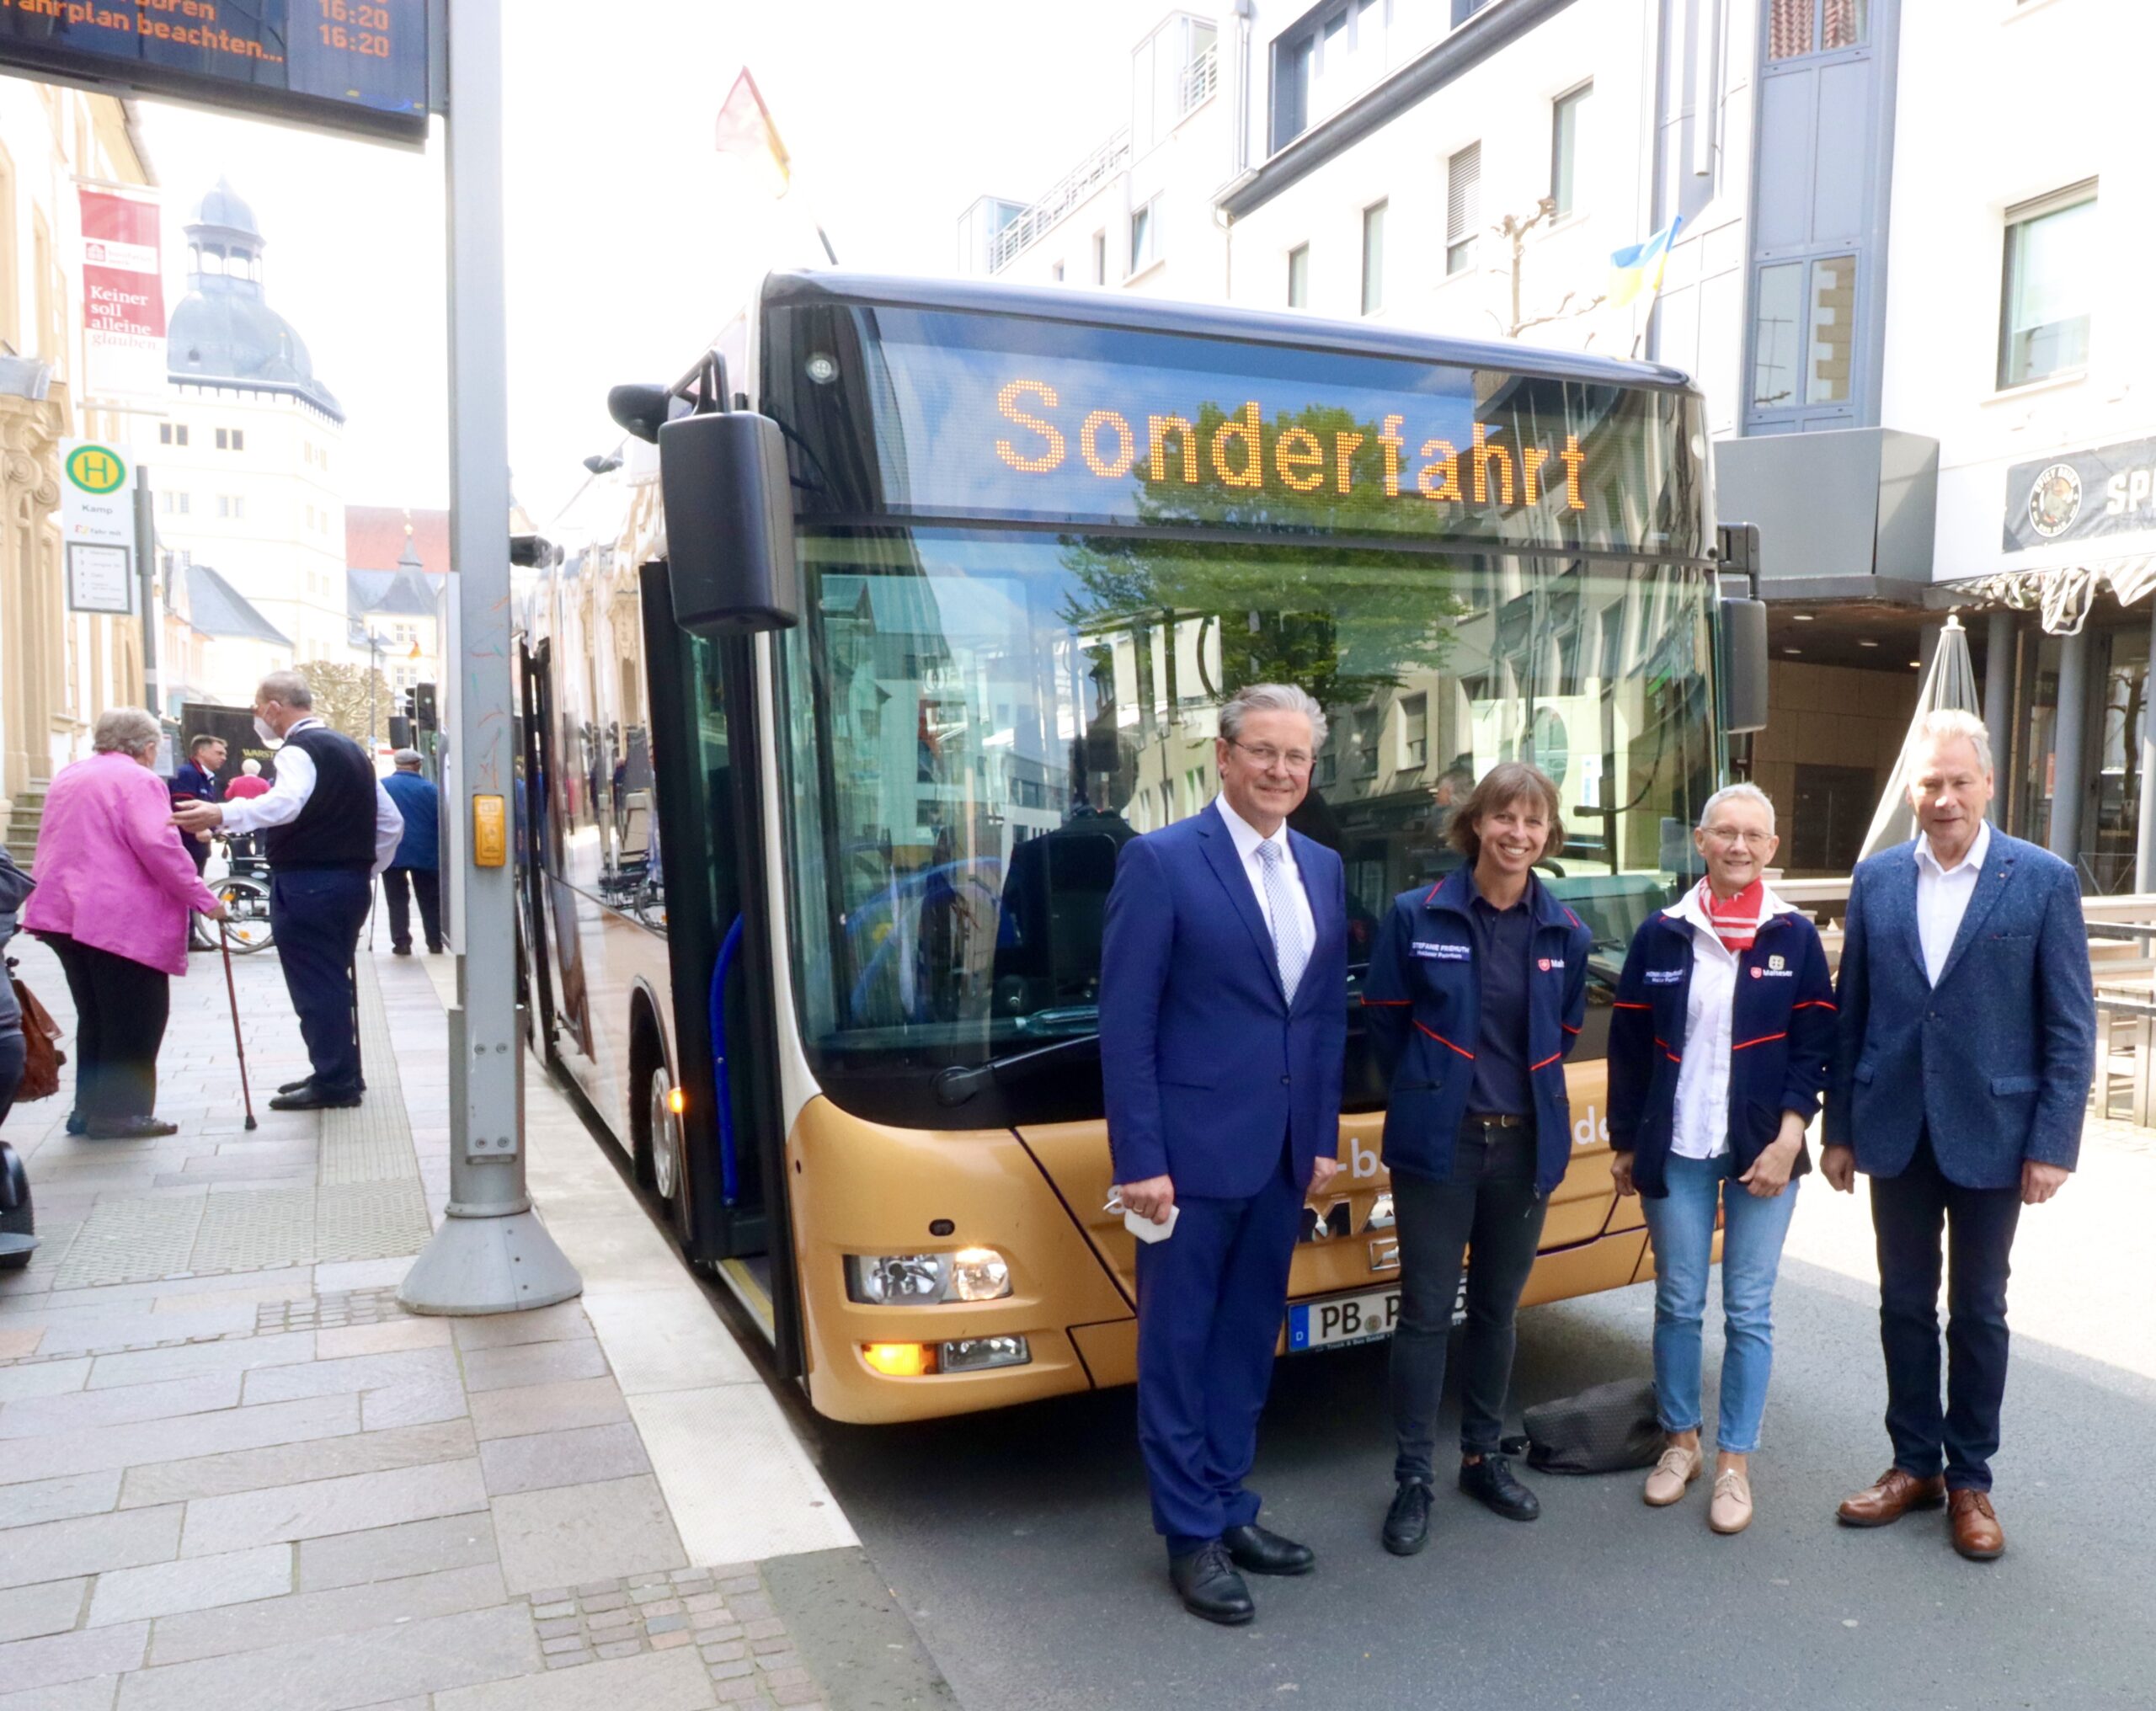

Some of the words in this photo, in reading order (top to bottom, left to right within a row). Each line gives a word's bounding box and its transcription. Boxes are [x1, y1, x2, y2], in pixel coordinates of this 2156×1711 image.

[319, 0, 389, 30] 16:20
[137, 13, 284, 63] beachten...
[319, 24, 389, 58] 16:20
[90, 285, 149, 306] Keiner
[90, 303, 122, 317] soll
[91, 317, 152, 335] alleine
[996, 379, 1587, 510] Sonderfahrt
[83, 456, 108, 484] H
[82, 504, 113, 514] Kamp
[242, 749, 278, 759] WARST
[1298, 1193, 1396, 1243] MA
[1295, 1331, 1304, 1341] D
[1321, 1302, 1360, 1338] PB
[1385, 1295, 1401, 1326] P
